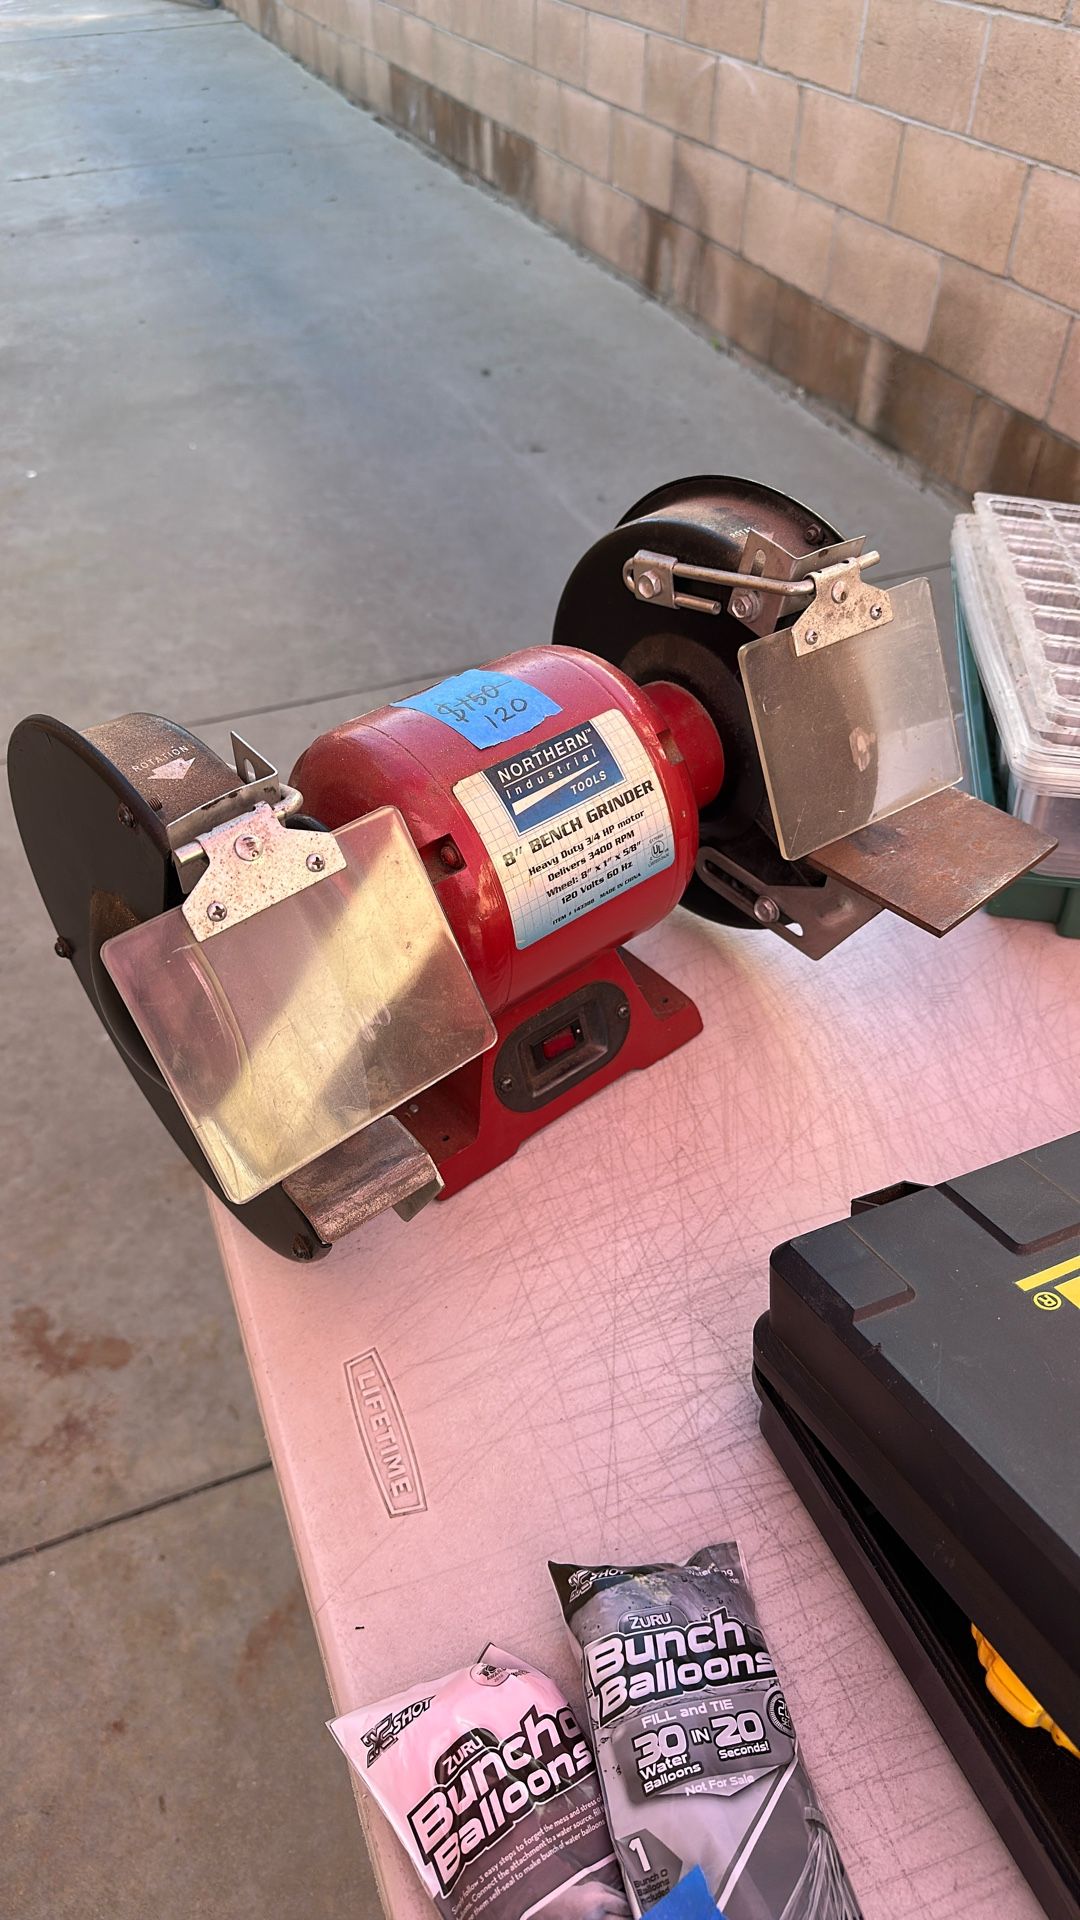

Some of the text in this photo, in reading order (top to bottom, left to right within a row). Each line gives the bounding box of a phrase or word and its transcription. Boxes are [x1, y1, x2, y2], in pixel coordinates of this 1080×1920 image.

[484, 699, 527, 728] 120
[131, 745, 190, 772] ROTATION
[506, 749, 597, 799] Industrial
[570, 770, 607, 795] TOOLS
[528, 816, 583, 854] BENCH
[586, 779, 655, 824] GRINDER
[528, 810, 645, 876] Heavy Duty 3/4 HP motor
[547, 857, 587, 882] Delivers
[588, 841, 613, 861] 3400
[615, 829, 636, 846] RPM
[546, 876, 579, 898] Wheel:
[595, 863, 601, 871] x
[561, 891, 578, 905] 120
[580, 876, 605, 894] Volts
[606, 868, 619, 881] 60
[621, 860, 633, 873] Hz
[552, 914, 567, 925] ITEM
[600, 886, 616, 899] MADE
[356, 1370, 414, 1498] LIFETIME
[628, 1611, 672, 1630] ZURU
[587, 1612, 746, 1687] Bunch
[599, 1651, 775, 1718] Balloons
[641, 1698, 734, 1729] FILL and TIE
[442, 1735, 484, 1774] ZURU
[633, 1711, 765, 1770] 30 IN 20
[718, 1740, 770, 1760] Seconds!
[639, 1753, 689, 1780] Water
[643, 1763, 702, 1794] Balloons
[684, 1773, 755, 1797] Not For Sale
[434, 1742, 593, 1885] Balloons
[479, 1875, 485, 1883] 3
[484, 1863, 499, 1878] easy
[499, 1850, 517, 1866] steps
[516, 1843, 525, 1852] to
[523, 1827, 545, 1846] forget
[543, 1823, 554, 1833] the
[553, 1815, 570, 1827] mess
[569, 1806, 581, 1818] and
[580, 1799, 597, 1812] stress
[628, 1837, 652, 1872] 1
[472, 1876, 498, 1902] Connect
[498, 1868, 510, 1879] the
[510, 1839, 547, 1869] attachment
[545, 1836, 553, 1844] to
[556, 1825, 573, 1838] water
[473, 1898, 490, 1916] them
[489, 1874, 516, 1902] self-seal
[514, 1871, 524, 1881] to
[523, 1859, 542, 1875] make
[540, 1844, 560, 1861] bunch
[558, 1839, 565, 1849] of
[564, 1832, 581, 1846] water
[633, 1868, 668, 1888] Bunch O
[637, 1878, 670, 1896] Balloons
